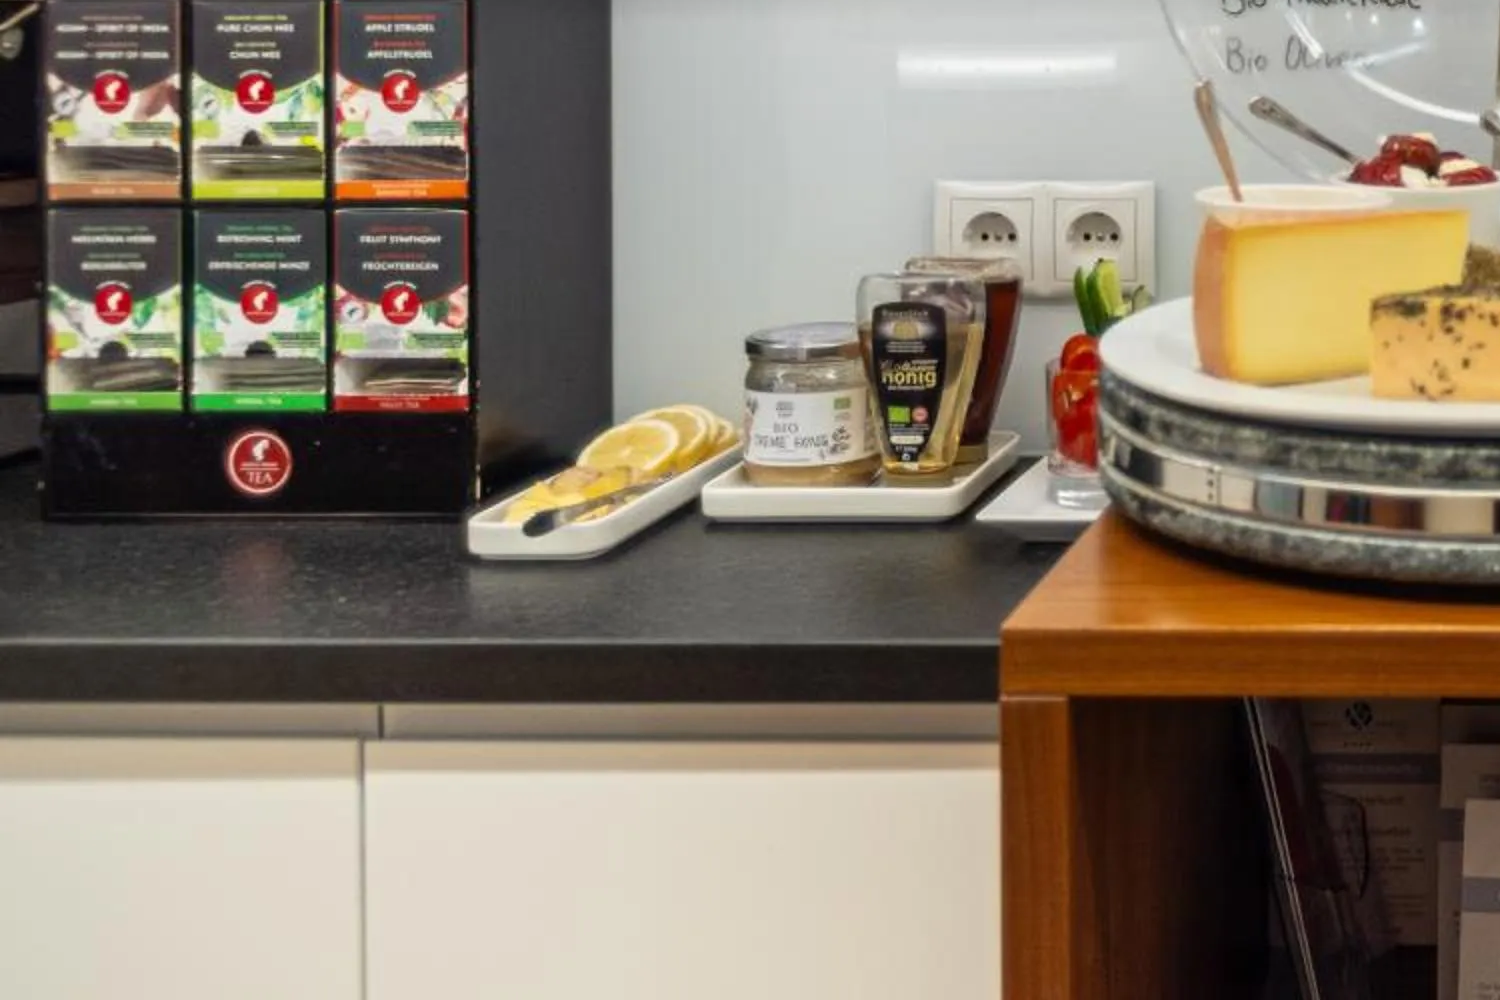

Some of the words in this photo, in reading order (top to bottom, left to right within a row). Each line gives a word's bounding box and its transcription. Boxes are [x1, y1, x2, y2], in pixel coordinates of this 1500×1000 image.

[365, 23, 393, 32] APPLE
[394, 23, 436, 32] STRUDEL
[247, 470, 274, 485] TEA
